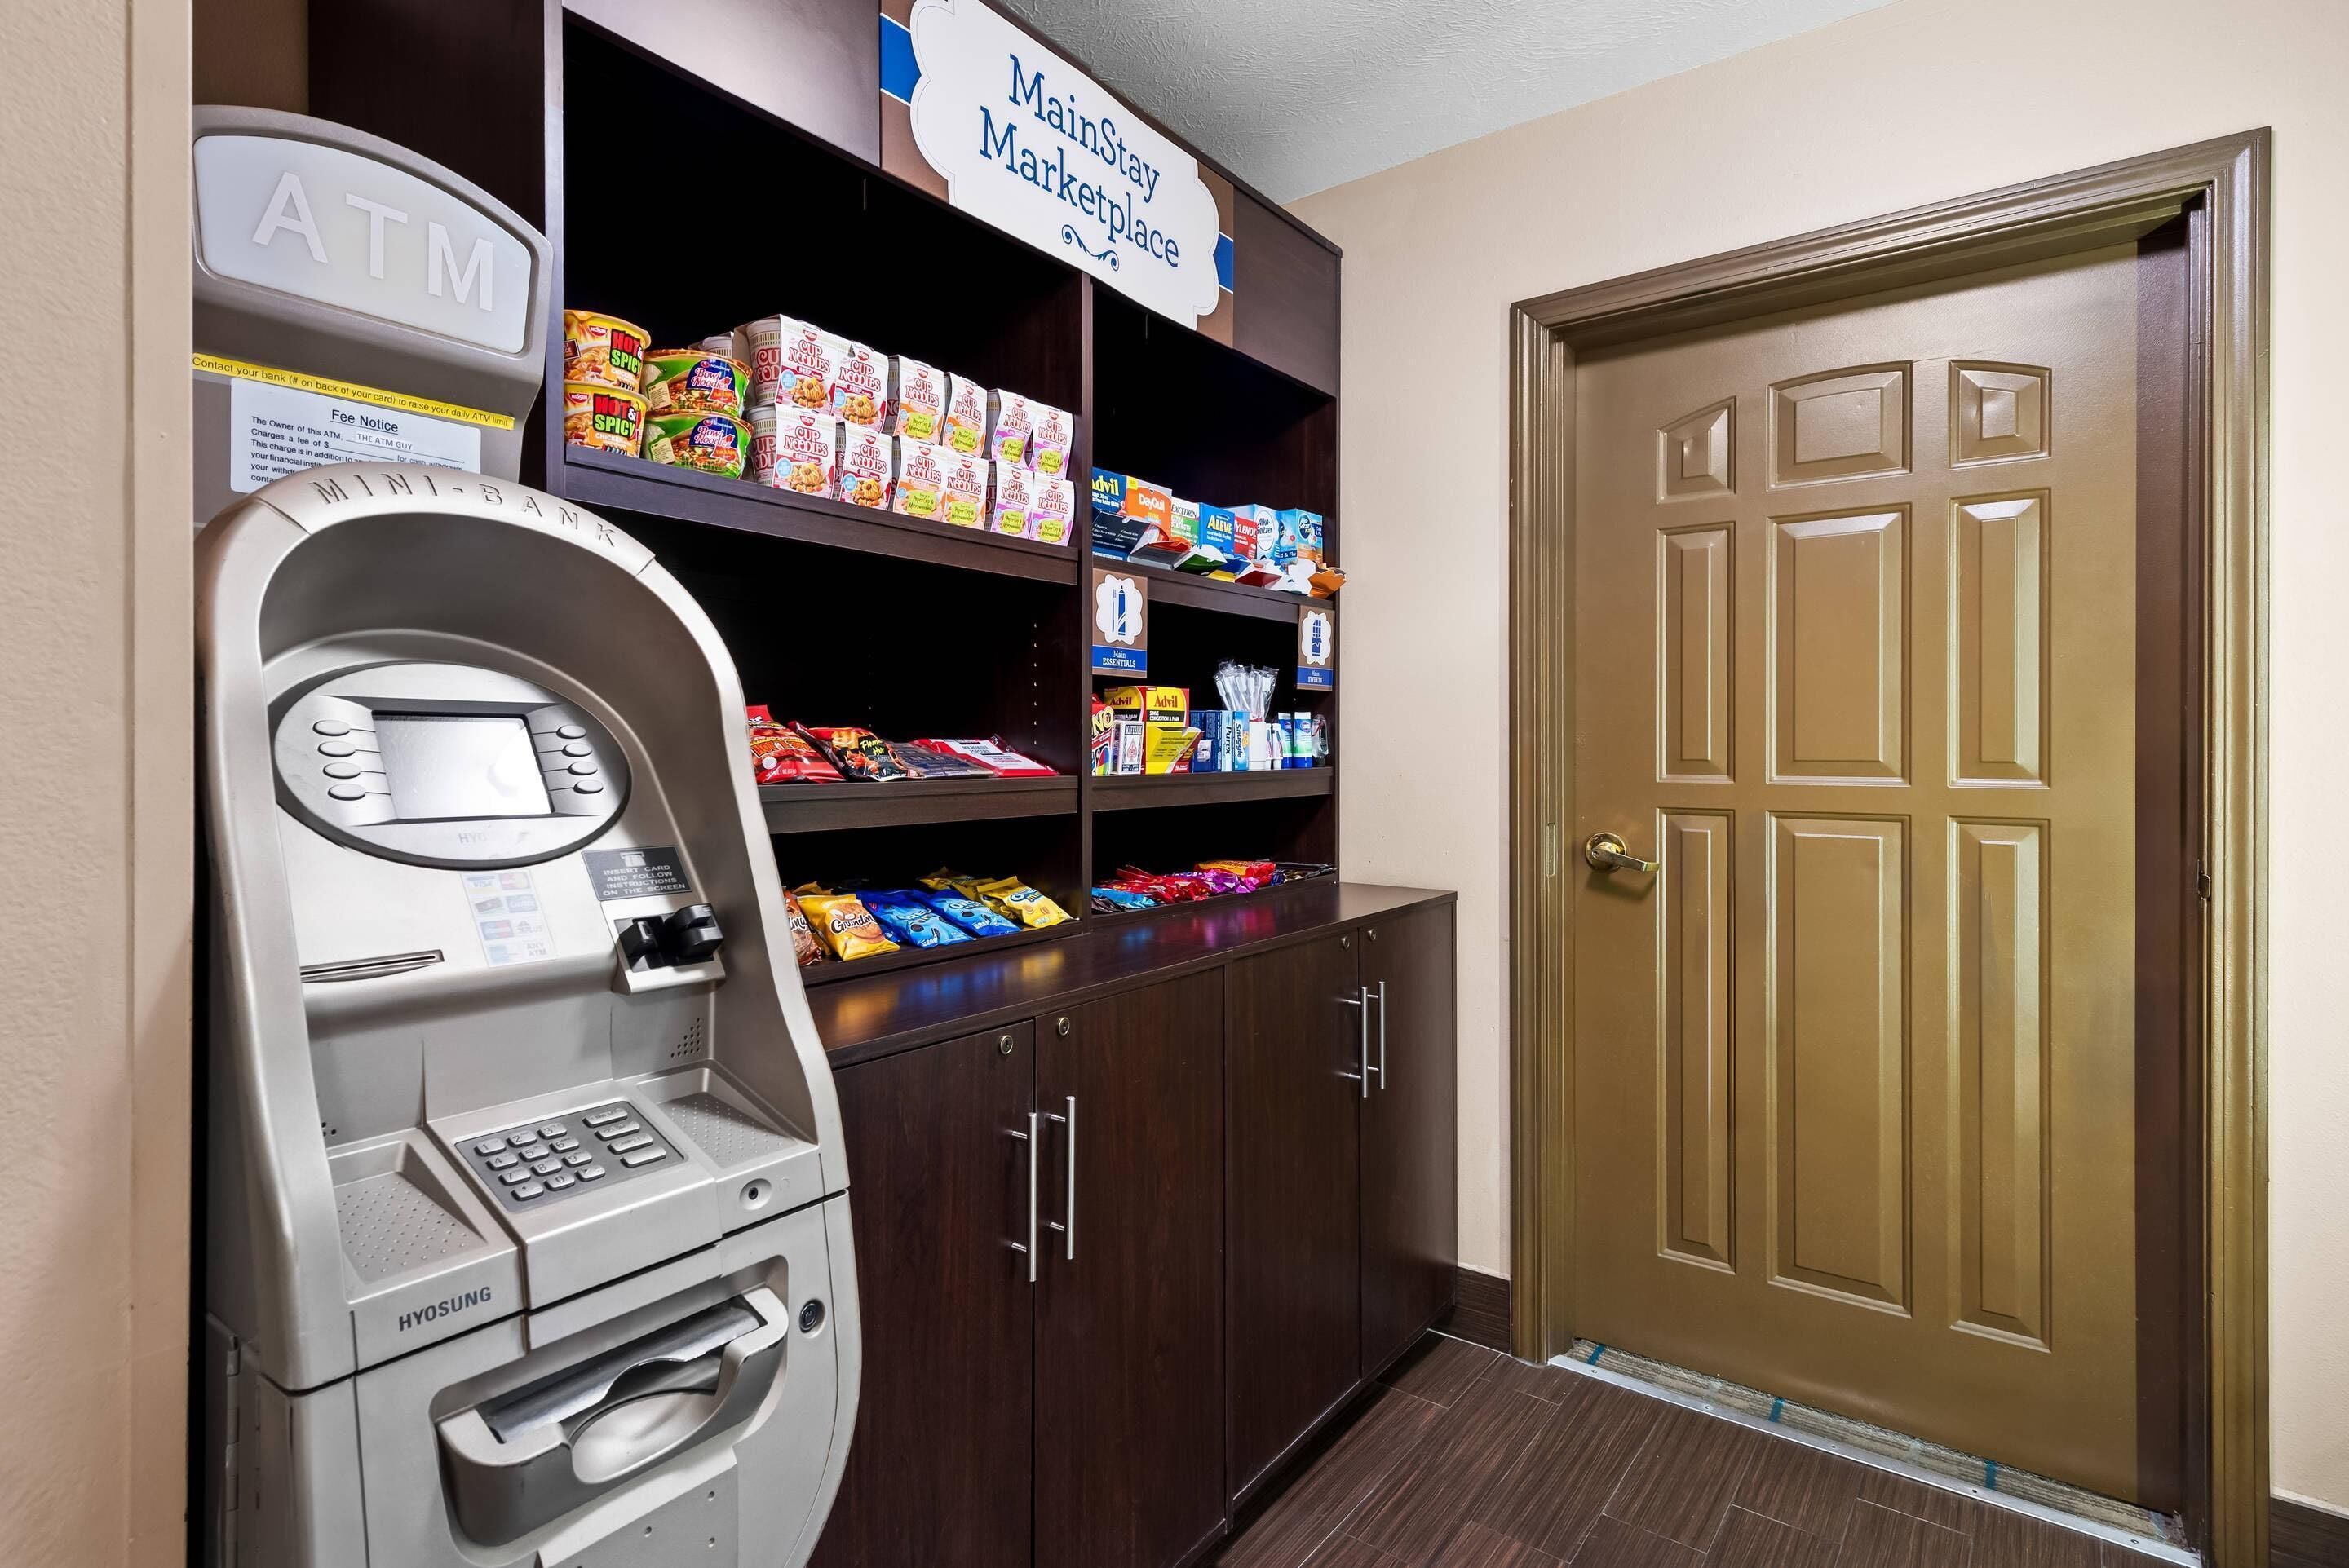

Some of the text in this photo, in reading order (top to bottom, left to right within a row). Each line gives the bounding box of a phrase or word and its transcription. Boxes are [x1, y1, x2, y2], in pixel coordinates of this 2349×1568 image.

[1008, 53, 1160, 203] MainStay
[979, 104, 1179, 268] Marketplace
[251, 171, 494, 311] ATM
[612, 330, 640, 356] HOT
[798, 339, 823, 358] CUP
[756, 348, 781, 366] CU
[788, 347, 830, 374] NOODLES
[694, 367, 721, 379] Bowl
[850, 359, 874, 377] CUP
[838, 366, 881, 392] NOODLES
[914, 378, 933, 393] CUP
[192, 356, 233, 373] Contact
[237, 367, 258, 377] your
[262, 369, 285, 382] bank
[289, 375, 299, 385] (#
[301, 379, 313, 388] on
[316, 378, 338, 392] back
[340, 385, 349, 395] of
[352, 389, 372, 399] your
[373, 393, 396, 405] card)
[398, 398, 406, 406] to
[409, 400, 429, 411] raise
[431, 404, 449, 414] your
[451, 408, 470, 420] daily
[471, 413, 490, 423] ATM
[905, 384, 939, 408] NOODLES
[595, 396, 636, 422] HOT &
[962, 393, 978, 408] CUP
[332, 409, 399, 432] Fee Notice
[953, 400, 982, 423] NOODLES
[1012, 406, 1029, 421] CUP
[251, 416, 267, 425] The
[269, 419, 294, 431] Owner
[307, 426, 321, 436] this
[357, 433, 373, 443] THE
[374, 437, 393, 447] ATM
[396, 441, 414, 450] GUY
[594, 413, 636, 436] SPICY
[697, 425, 724, 436] Bowl
[1004, 413, 1032, 434] NOODLES
[1045, 419, 1062, 433] CUP
[794, 425, 821, 443] CUP
[1038, 426, 1068, 445] NOODLES
[251, 427, 285, 441] Charges
[297, 436, 310, 445] fee
[397, 455, 407, 463] for
[251, 439, 268, 448] This
[269, 444, 297, 454] charge
[298, 447, 304, 455] is
[314, 450, 344, 462] addition
[783, 435, 829, 457] NOODLES
[860, 443, 881, 459] CUP
[250, 452, 303, 466] your financial
[250, 463, 268, 471] your
[850, 452, 887, 475] NOODLES
[915, 455, 936, 470] CUP
[250, 474, 274, 484] conta
[906, 463, 942, 484] NOODLES
[956, 467, 976, 484] CUP
[947, 475, 982, 496] NOODLES
[1007, 479, 1024, 492] CUP
[1046, 488, 1064, 501] CUP
[1001, 486, 1029, 506] NOODLES
[1037, 496, 1069, 514] NOODLES
[1139, 492, 1166, 512] DayQuil
[310, 473, 617, 548] MINI-BANK
[1172, 503, 1197, 518] EXCEDRIN
[1207, 515, 1232, 534] ALEVE
[1102, 657, 1136, 668] ESSENTIALS
[1113, 649, 1126, 659] Main
[1109, 696, 1132, 706] Advil
[1154, 694, 1178, 708] Advil
[1092, 705, 1114, 739] NO
[603, 864, 671, 876] INSERT CARD
[606, 871, 673, 882] AND FOLLOW
[606, 877, 678, 889] INSTRUCTIONS
[647, 883, 686, 892] SCREEN
[830, 913, 875, 934] Grandm
[398, 1286, 492, 1333] HYOSUNG
